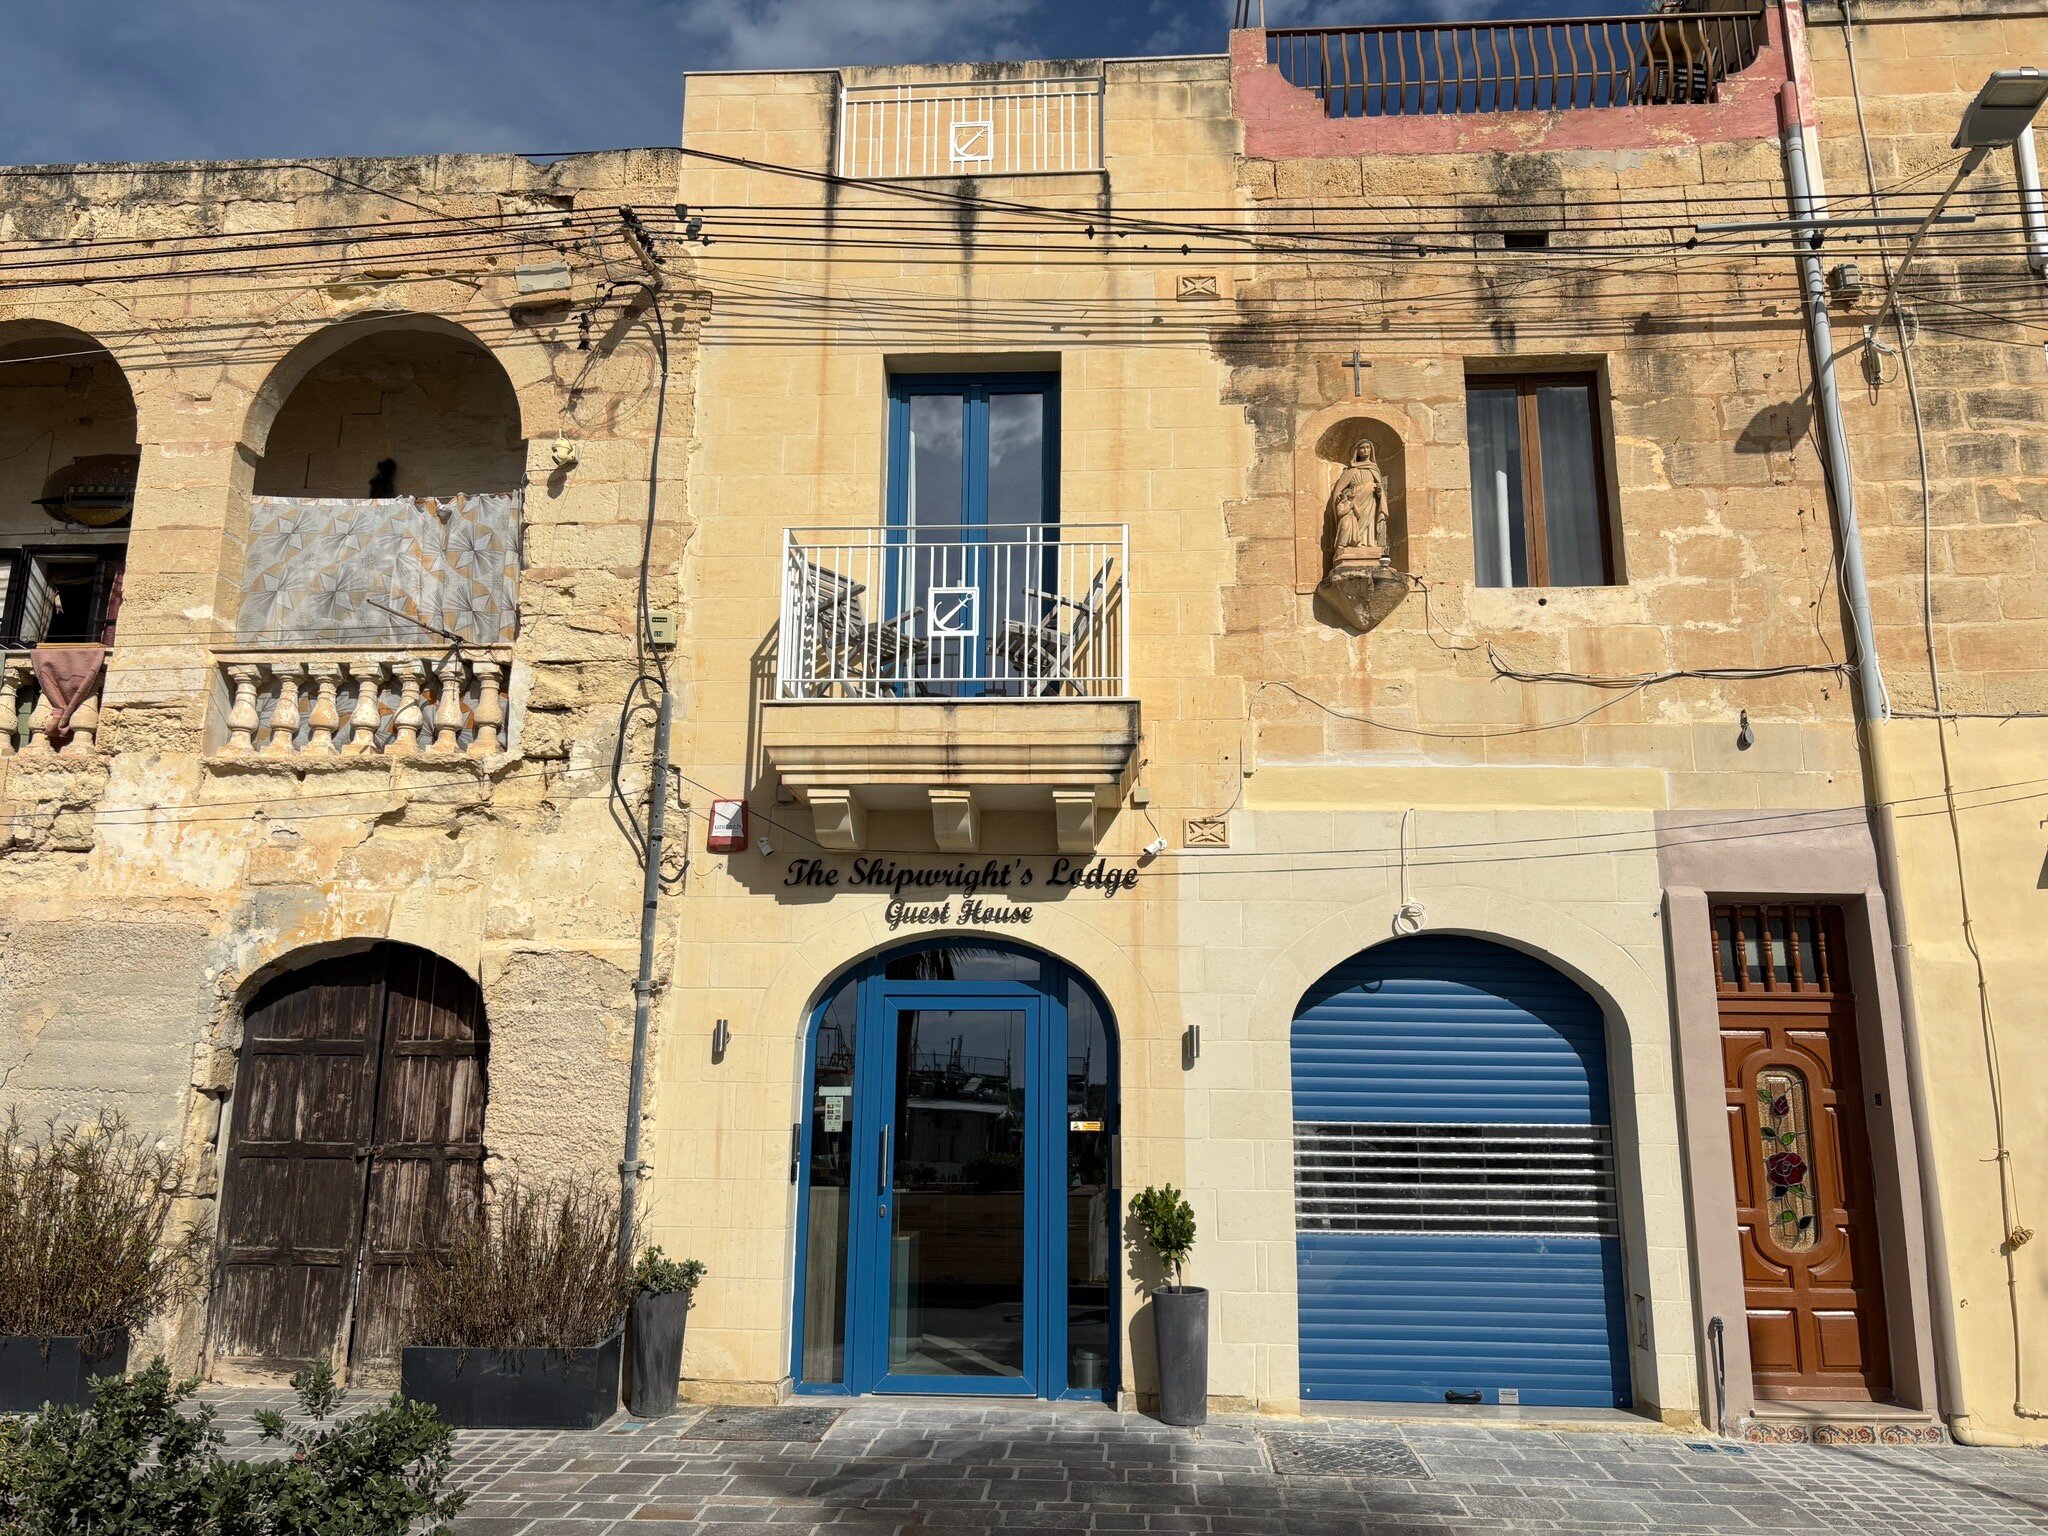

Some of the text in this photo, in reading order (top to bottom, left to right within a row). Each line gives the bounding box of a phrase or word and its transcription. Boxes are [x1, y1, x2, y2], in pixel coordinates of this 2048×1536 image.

[784, 857, 1139, 898] The Shipwright's Lodge
[885, 898, 1033, 931] Guest House
